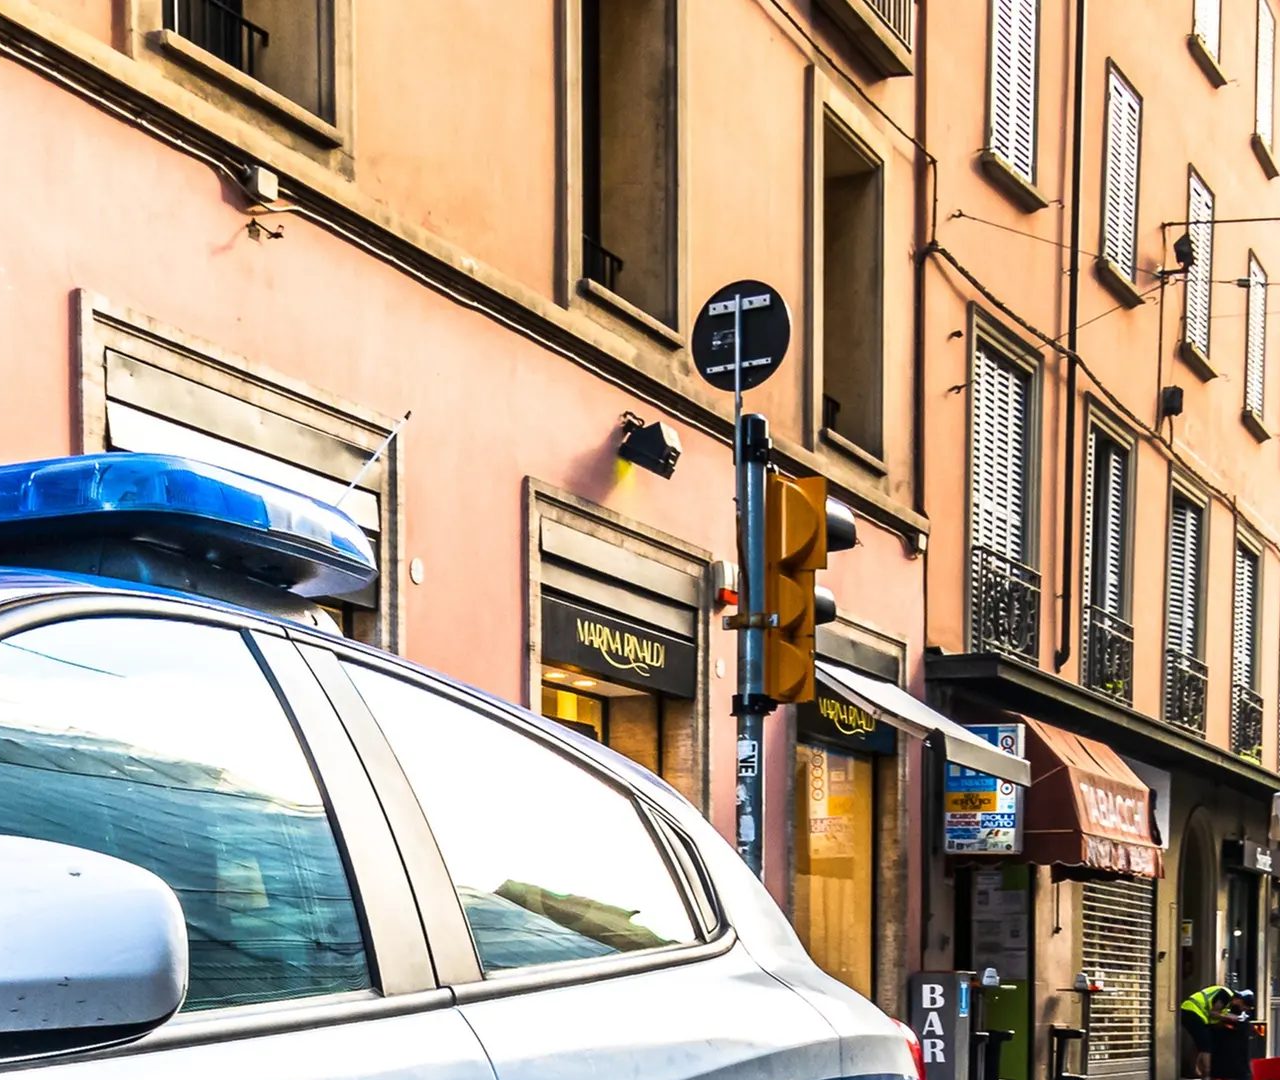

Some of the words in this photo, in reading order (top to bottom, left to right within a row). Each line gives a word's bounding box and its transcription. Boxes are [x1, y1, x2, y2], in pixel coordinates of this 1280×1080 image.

[577, 617, 622, 668] MARINA
[623, 632, 665, 677] RINALDI
[1080, 782, 1146, 837] TABACCHI
[922, 984, 946, 1063] BAR
